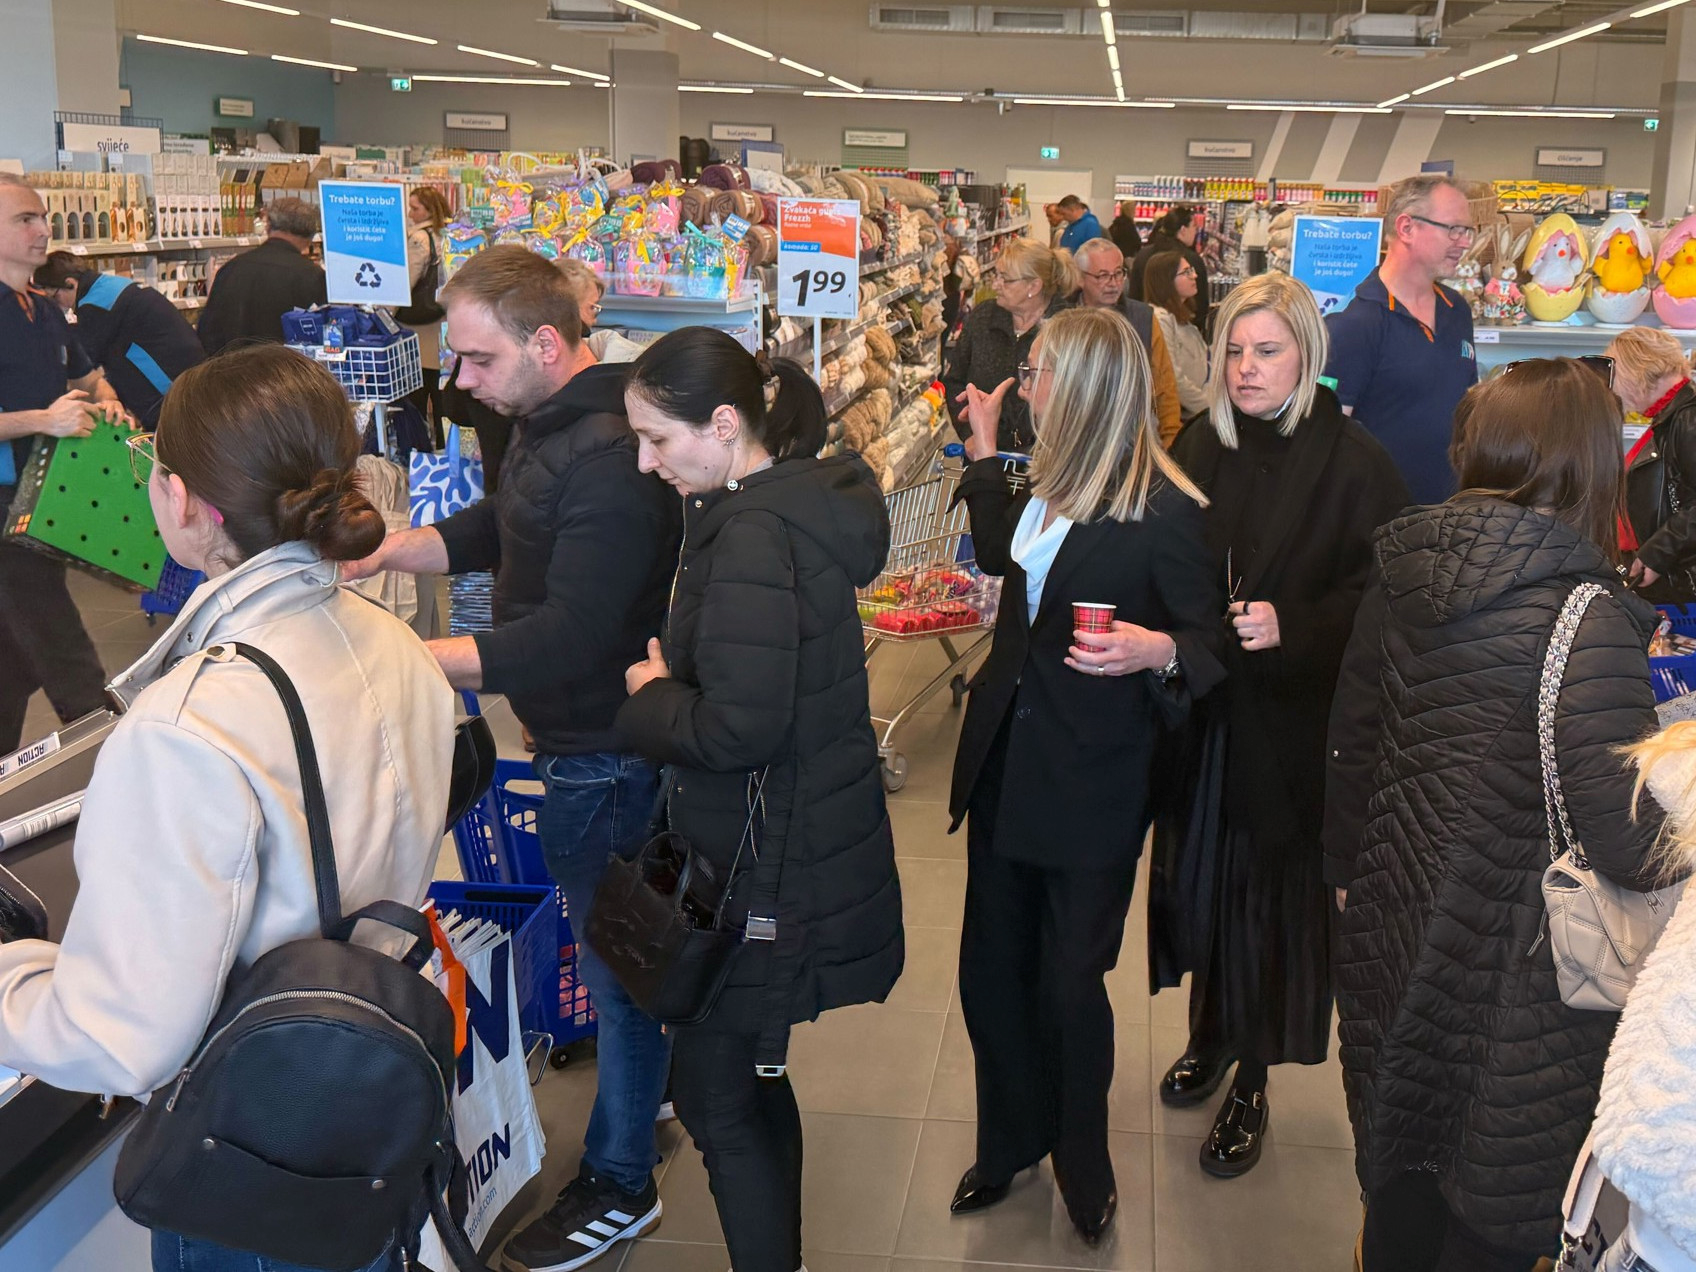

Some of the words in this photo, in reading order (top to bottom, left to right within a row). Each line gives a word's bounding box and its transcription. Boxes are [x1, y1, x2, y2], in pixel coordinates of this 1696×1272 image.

[97, 137, 129, 153] svijeće
[329, 194, 364, 204] Trebate
[366, 196, 396, 205] torbu?
[359, 209, 376, 217] torba
[784, 214, 811, 222] Frezzh
[1303, 230, 1340, 239] Trebate
[1341, 231, 1373, 240] torbu?
[17, 743, 44, 766] ACTION
